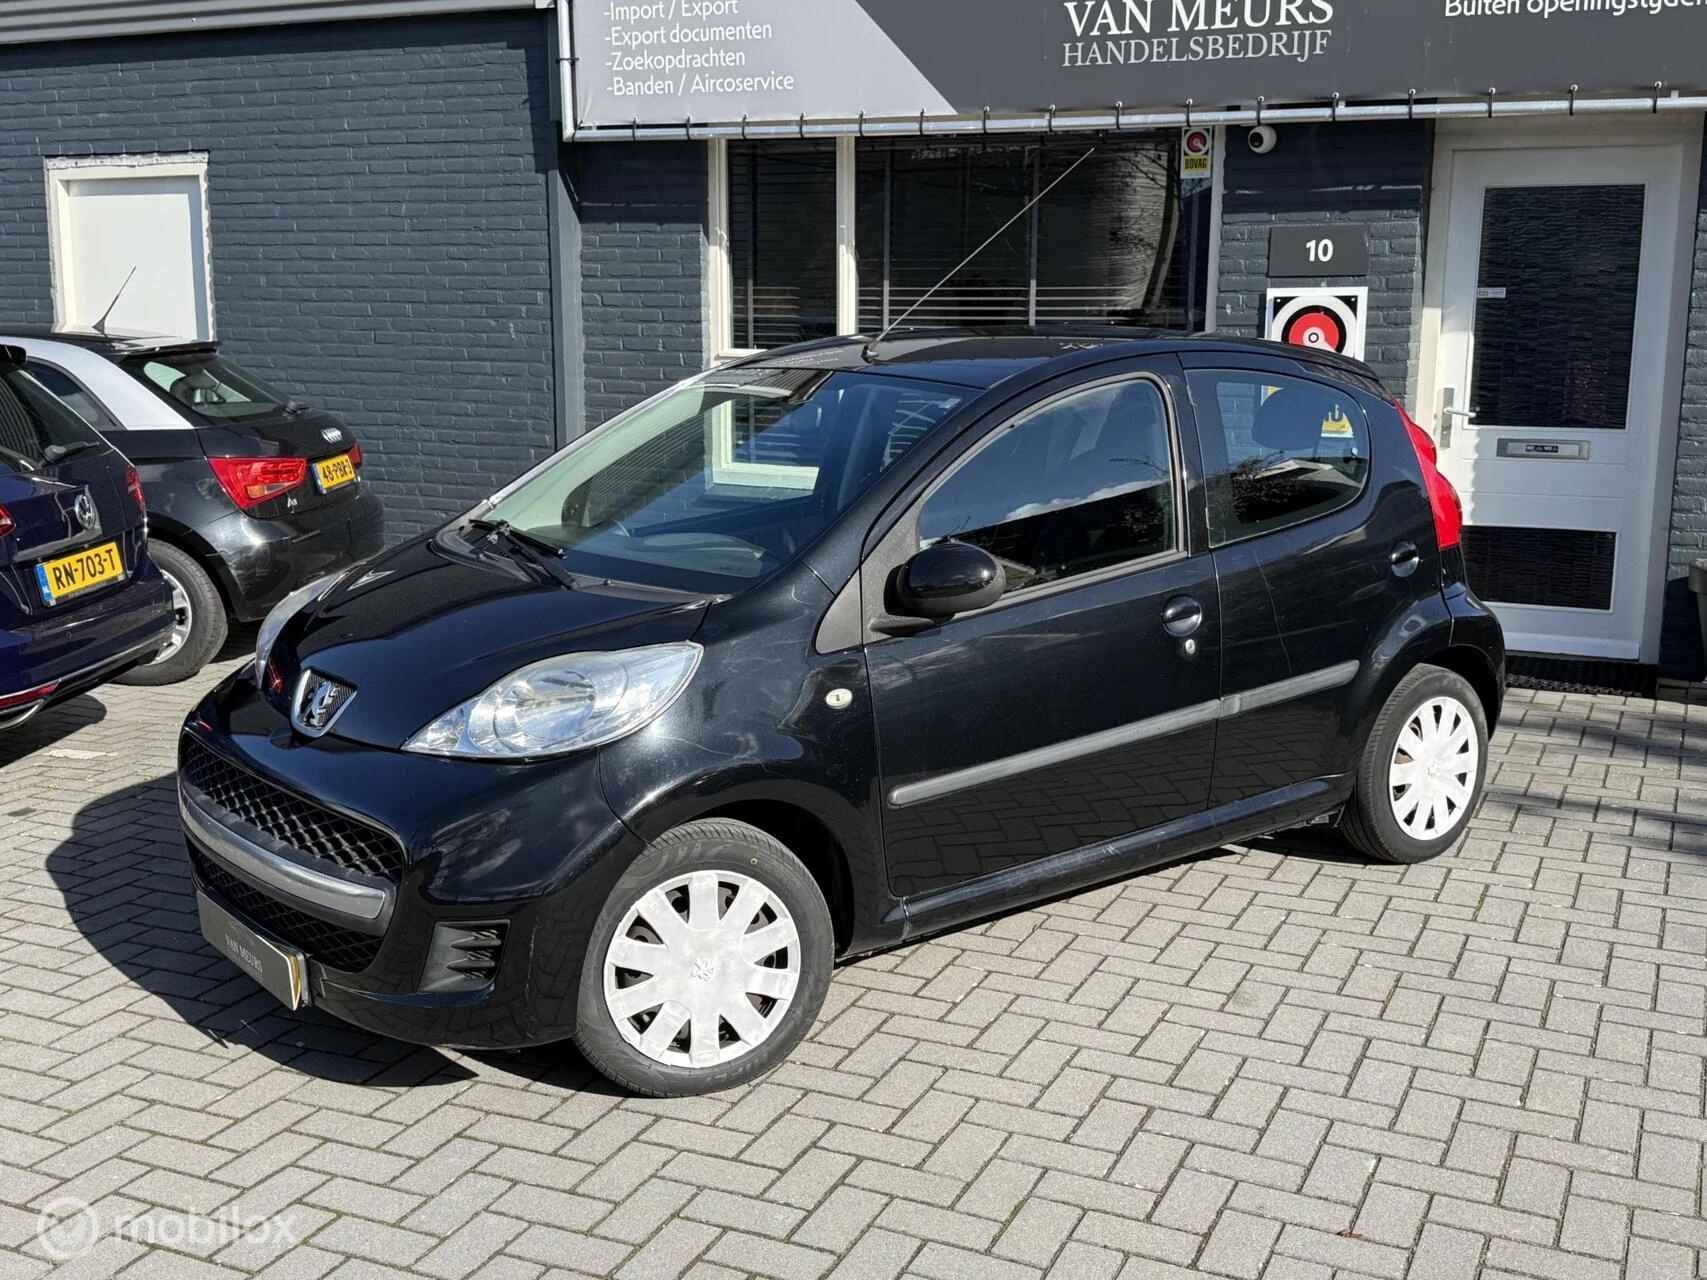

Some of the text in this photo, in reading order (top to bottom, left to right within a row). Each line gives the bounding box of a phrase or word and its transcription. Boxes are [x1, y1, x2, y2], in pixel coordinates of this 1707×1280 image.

[603, 0, 739, 24] -Import / Export
[1063, 0, 1334, 37] VAN MEURS
[1526, 0, 1707, 19] openingsy
[604, 22, 772, 50] -Export documenten
[1061, 29, 1333, 67] HANDELSBEDRIJF
[605, 47, 746, 74] -Zoekopdrachten
[606, 71, 795, 97] -Banden / Aircoservice
[1184, 157, 1208, 170] BOVAG
[1305, 239, 1334, 262] 10
[52, 548, 116, 591] RN-703-T
[225, 933, 239, 954] VAN
[239, 944, 263, 973] MEURS
